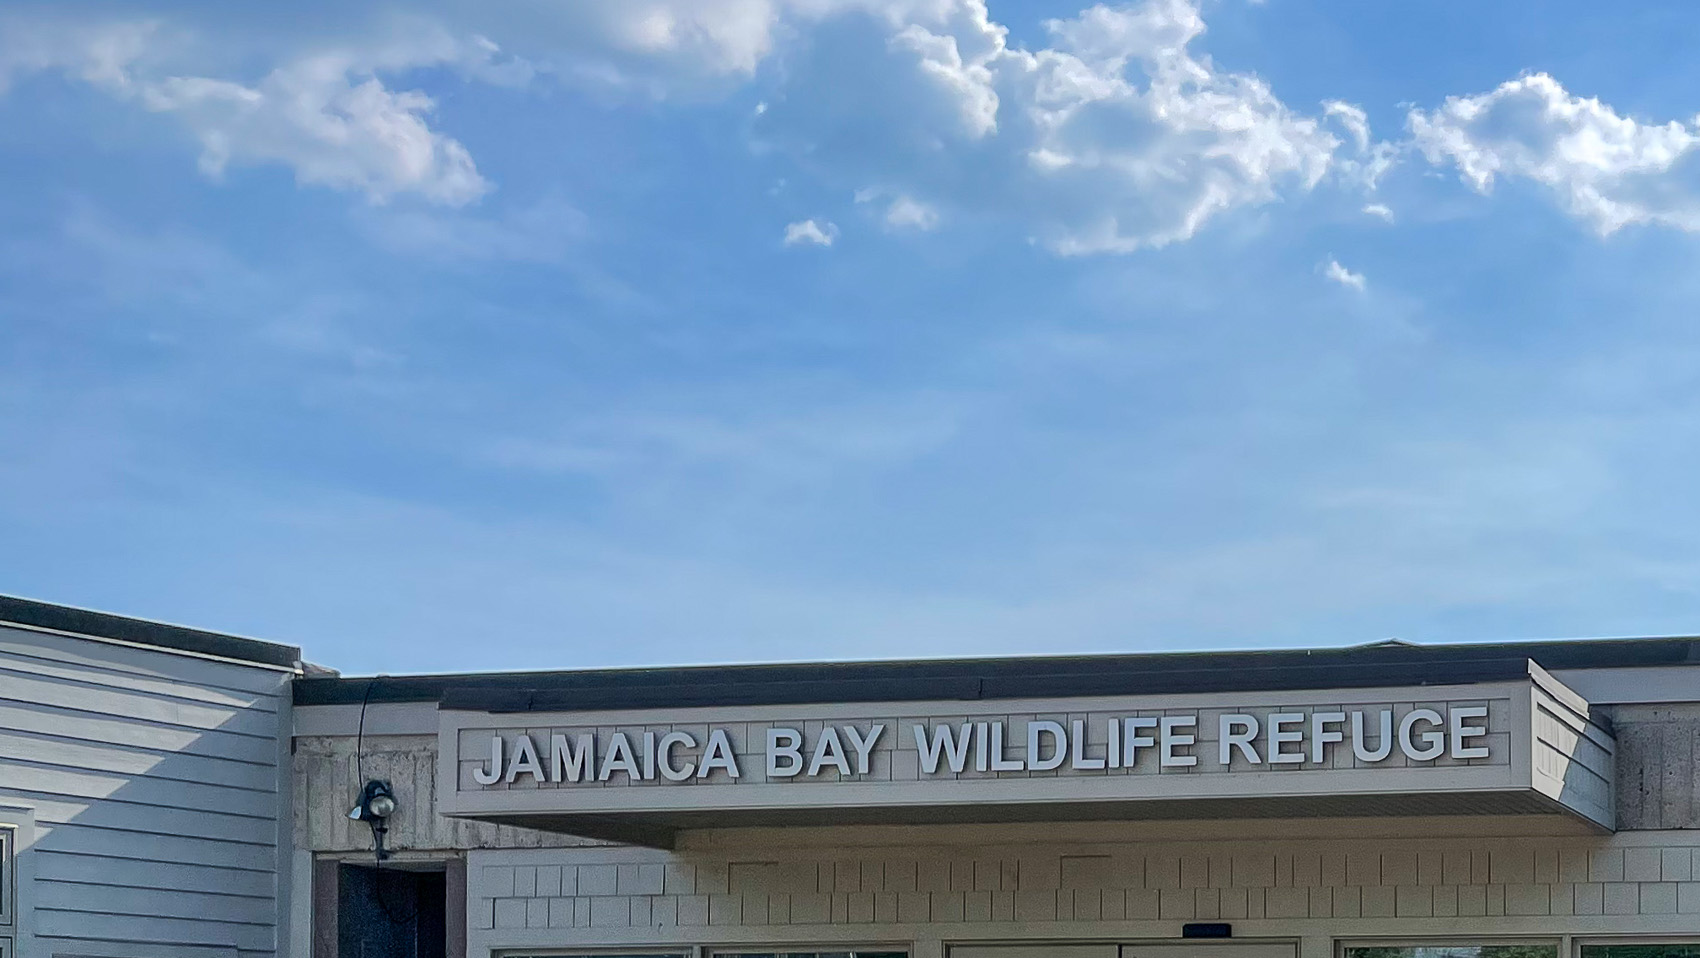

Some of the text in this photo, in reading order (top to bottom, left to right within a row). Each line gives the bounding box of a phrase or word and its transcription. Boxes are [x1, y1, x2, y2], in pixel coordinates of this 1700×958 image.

[473, 706, 1490, 785] JAMAICA BAY WILDLIFE REFUGE
